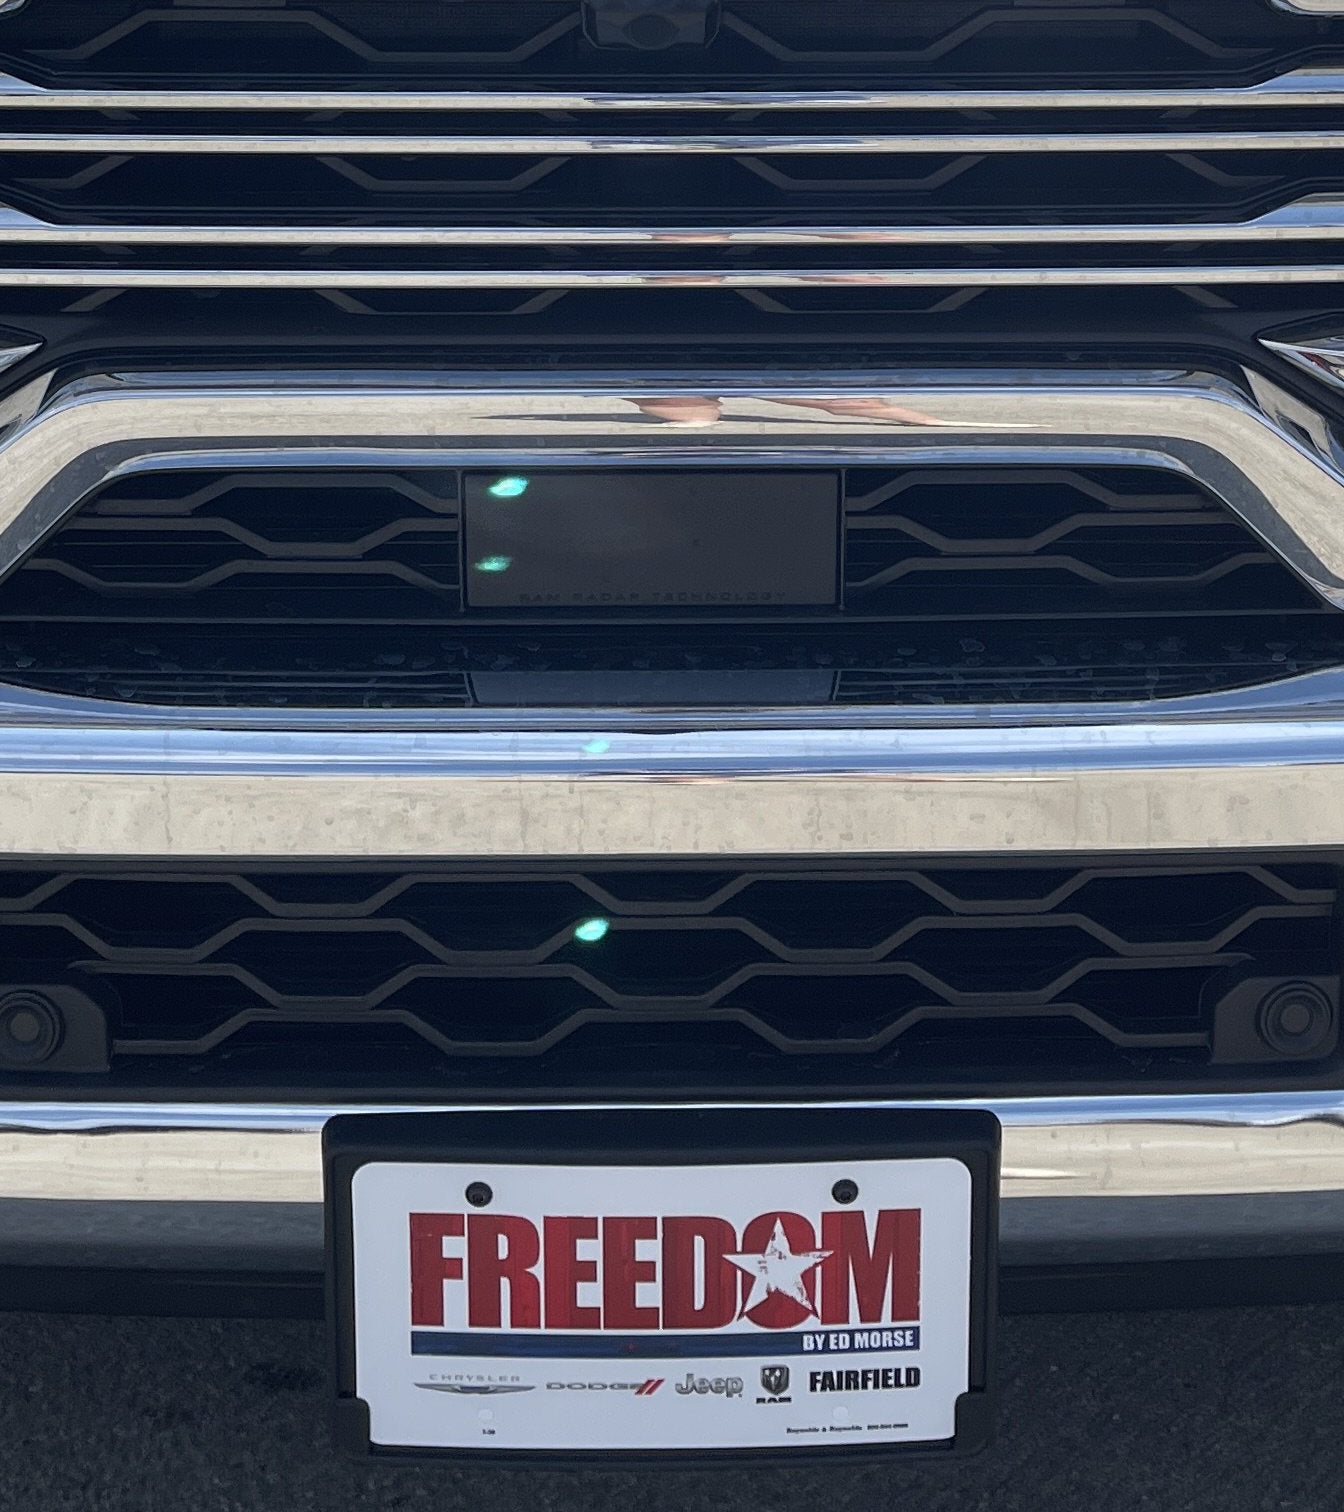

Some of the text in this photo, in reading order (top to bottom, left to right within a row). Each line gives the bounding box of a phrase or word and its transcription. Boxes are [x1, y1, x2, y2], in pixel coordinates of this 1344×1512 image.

[409, 1207, 922, 1329] FREEDOM
[803, 1330, 914, 1351] BY ED MORSE
[429, 1373, 521, 1383] CHRYSLER
[546, 1382, 643, 1391] DODGE
[675, 1373, 744, 1398] Jeep
[809, 1367, 921, 1392] FAIRFIELD
